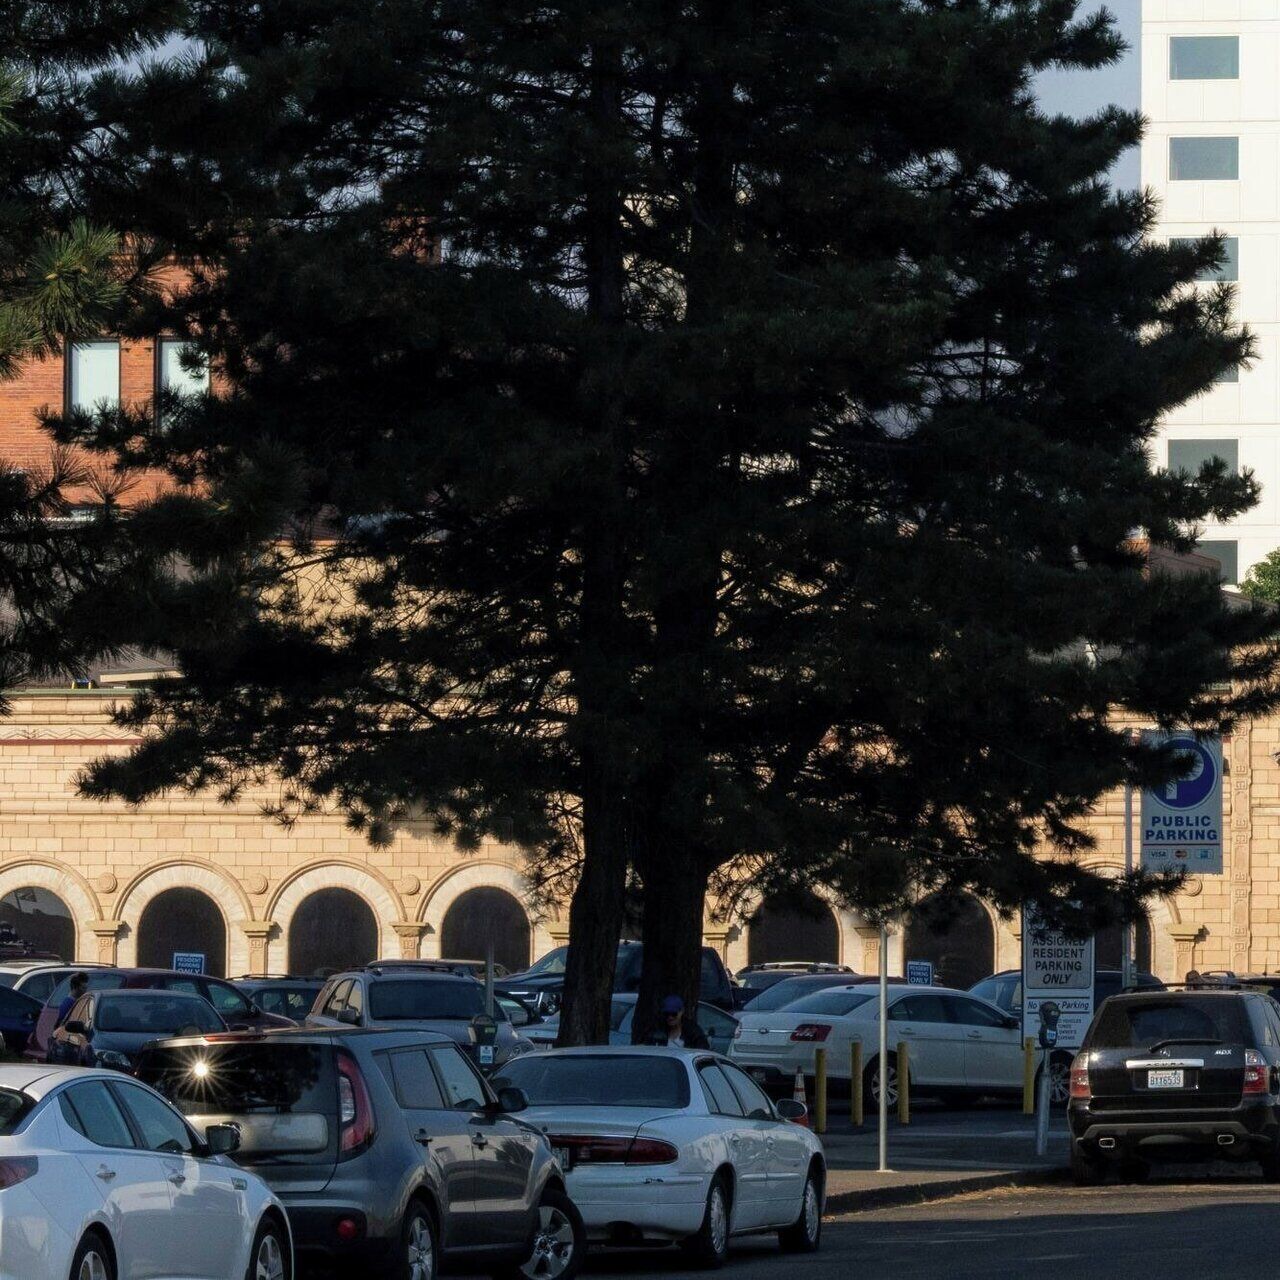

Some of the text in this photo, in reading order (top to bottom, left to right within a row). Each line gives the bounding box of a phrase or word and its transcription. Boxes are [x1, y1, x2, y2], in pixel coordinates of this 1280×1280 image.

[1151, 815, 1212, 827] PUBLIC
[1145, 829, 1218, 840] PARKING
[1032, 948, 1085, 959] RESIDENT
[1035, 961, 1082, 971] PARKING
[1042, 973, 1073, 984] ONLY
[1028, 1001, 1090, 1010] No Parking
